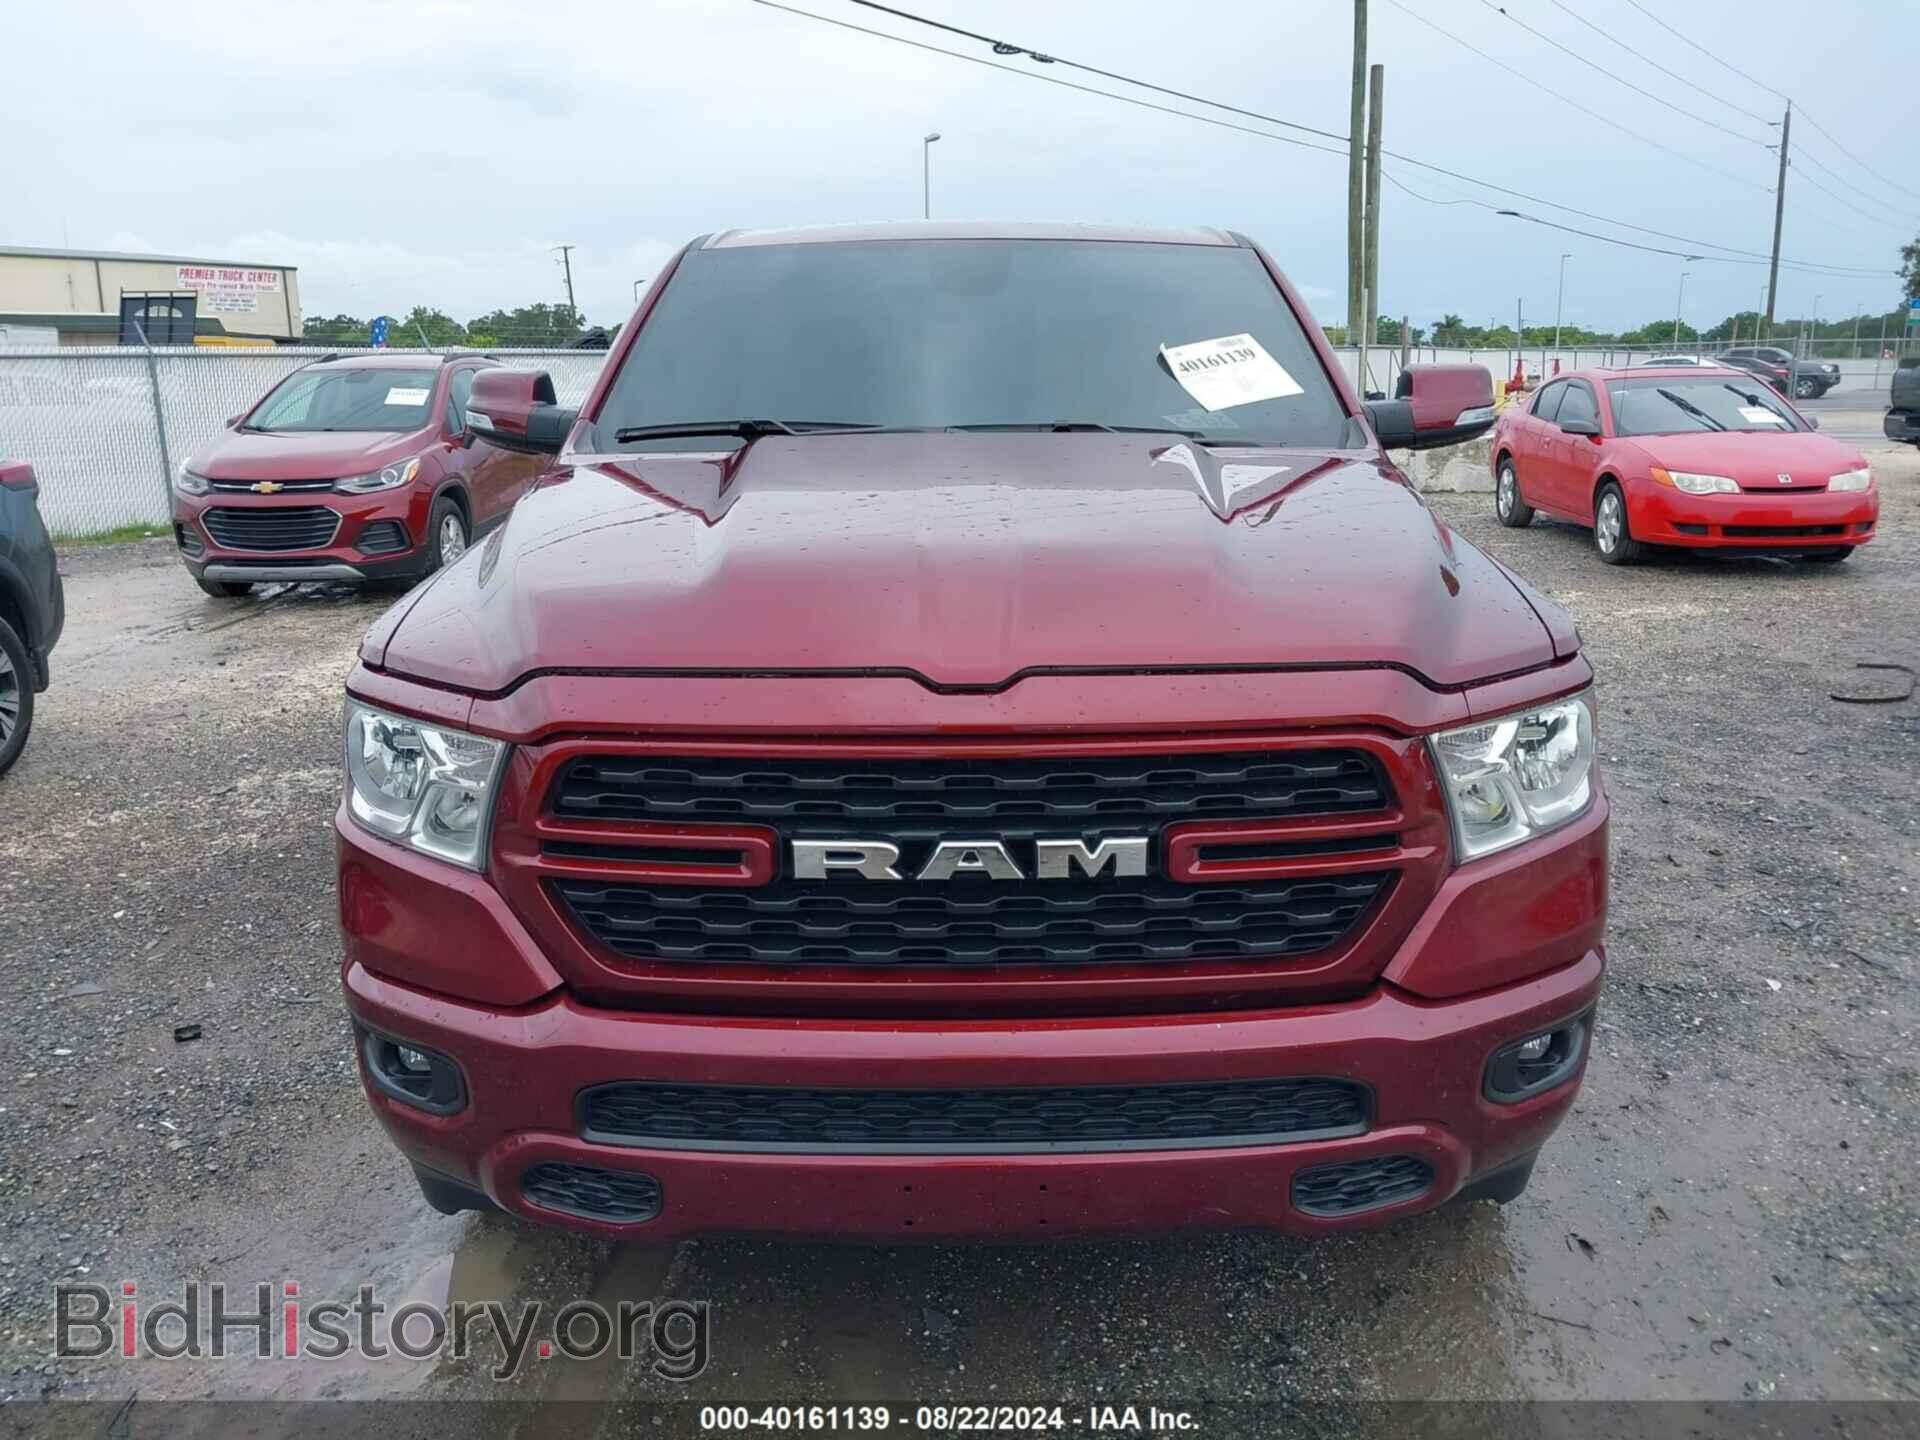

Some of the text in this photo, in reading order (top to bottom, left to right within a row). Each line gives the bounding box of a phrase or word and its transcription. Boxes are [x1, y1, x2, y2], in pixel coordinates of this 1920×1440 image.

[179, 268, 277, 283] PREMIER TRUCK CENTER
[1178, 347, 1256, 373] 40161139
[792, 837, 1149, 880] RAM
